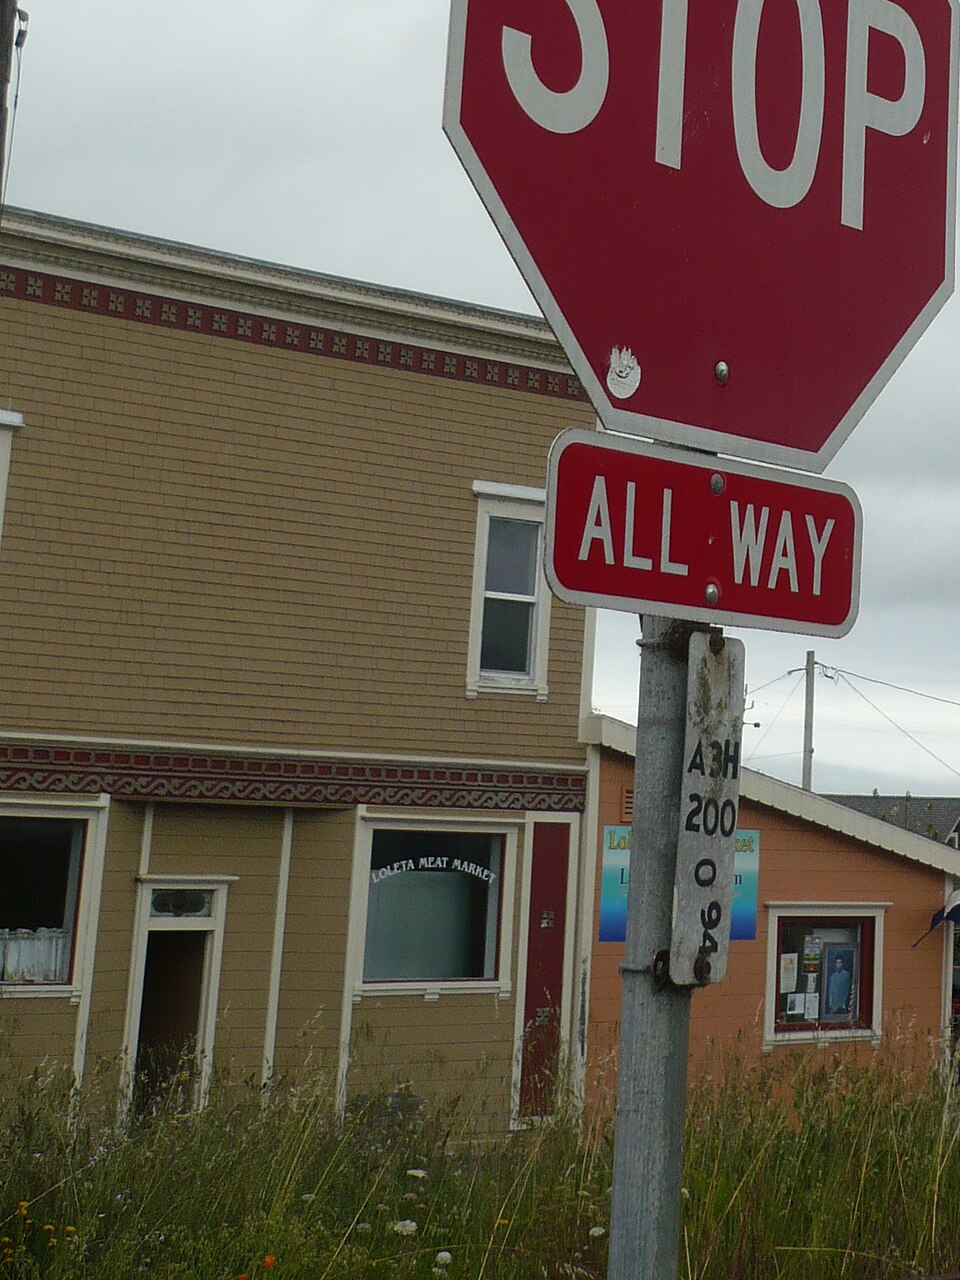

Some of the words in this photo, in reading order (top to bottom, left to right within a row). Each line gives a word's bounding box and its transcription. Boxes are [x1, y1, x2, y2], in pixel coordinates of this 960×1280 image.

[577, 475, 689, 576] ALL
[729, 500, 835, 596] WAY
[685, 792, 737, 838] 200
[371, 859, 415, 884] LOLETA
[418, 856, 449, 869] MEAT
[451, 858, 497, 884] MARKET
